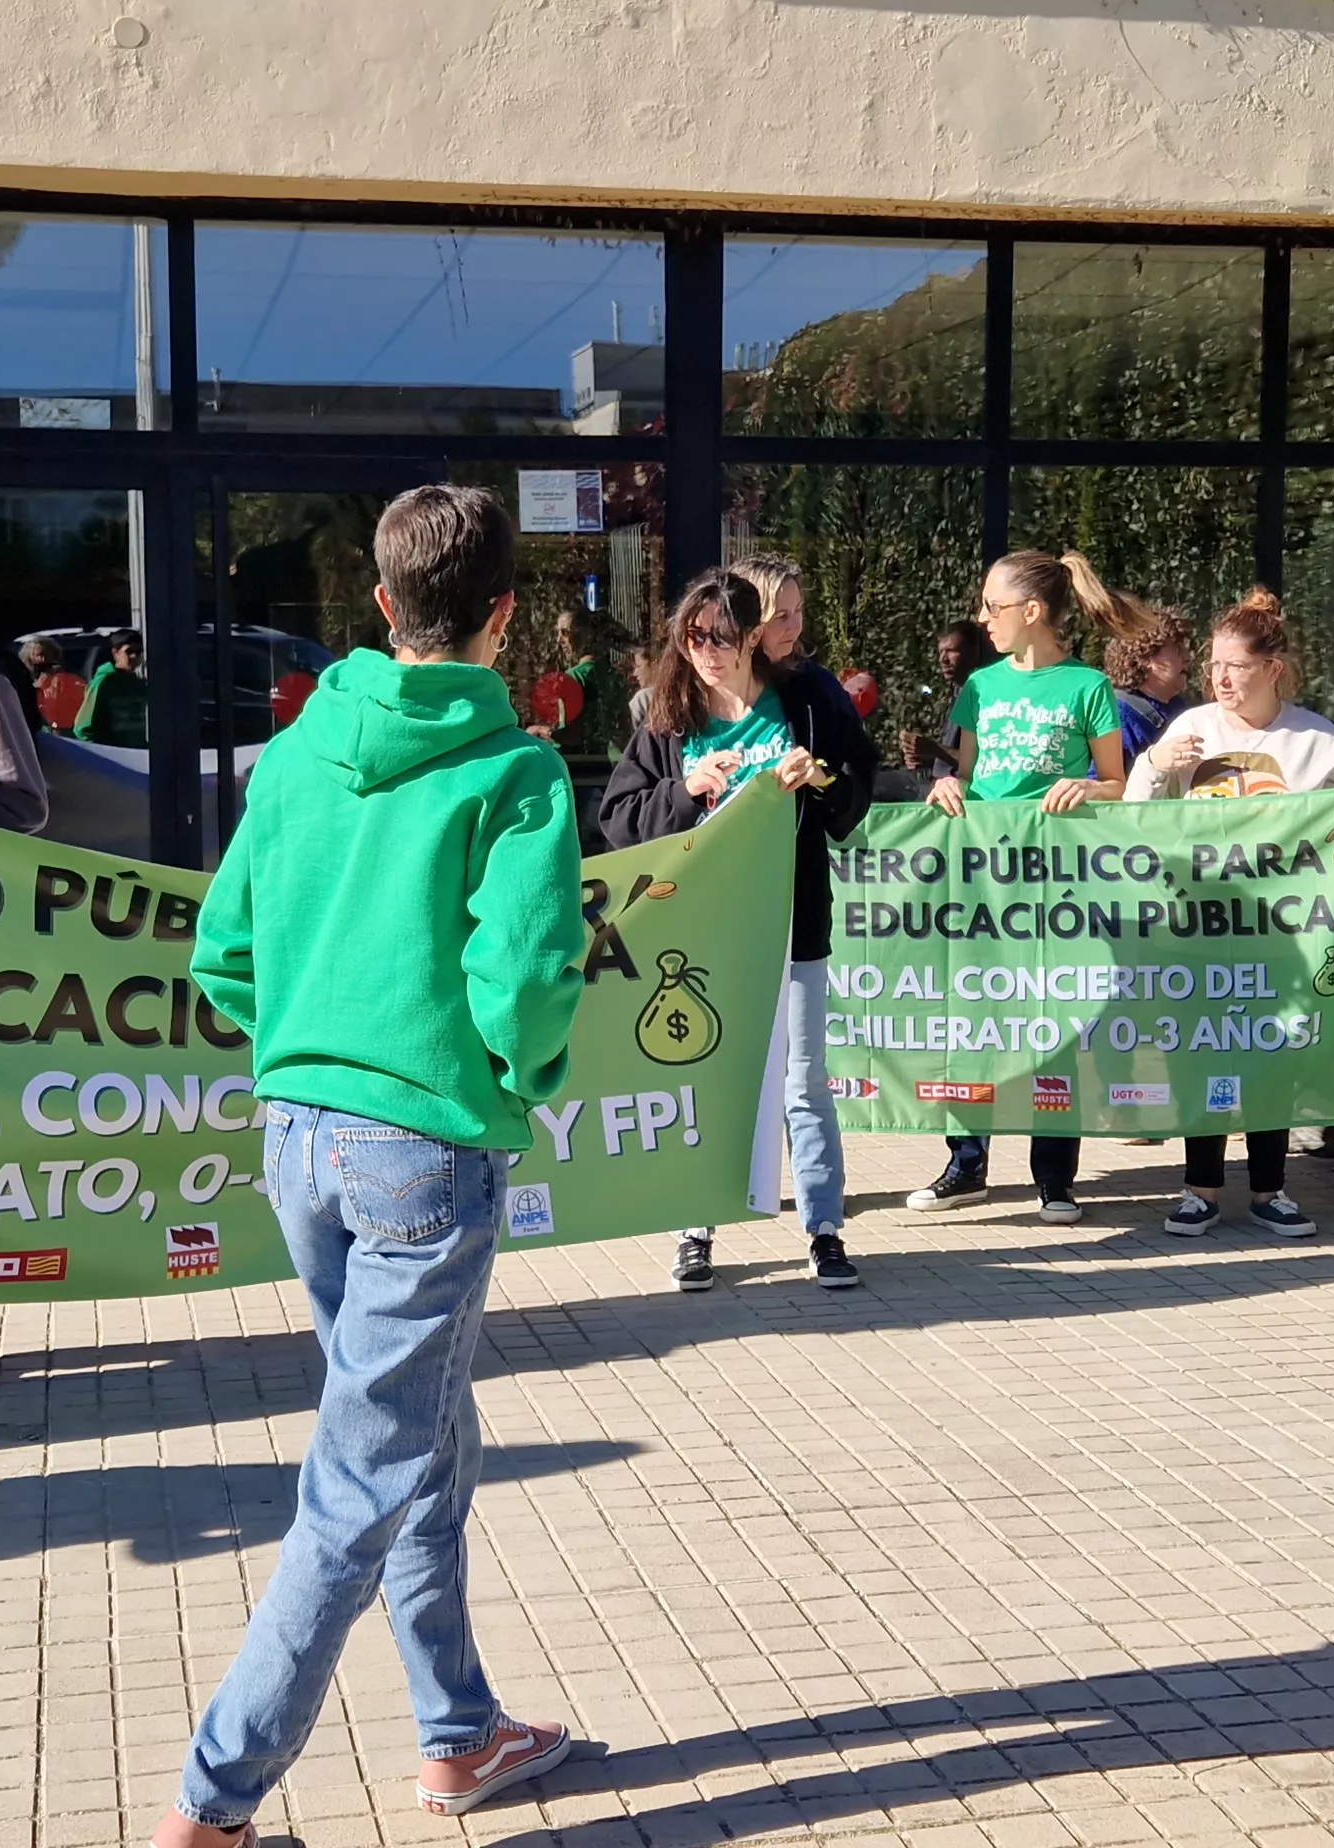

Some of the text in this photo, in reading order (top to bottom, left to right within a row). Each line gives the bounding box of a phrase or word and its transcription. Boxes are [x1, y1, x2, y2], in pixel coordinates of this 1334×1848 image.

[828, 834, 1328, 889] NERO PÚBLICO, PARA
[34, 865, 201, 941] PÚB
[845, 888, 1122, 941] EDUCACIÓN
[892, 965, 945, 1001] AL
[954, 964, 1195, 1002] CONCIERTO
[1205, 963, 1277, 1001] DEL
[825, 1004, 1322, 1052] CHILLERATO Y 0-3 AÑOS!
[918, 1084, 970, 1099] CCOO
[1034, 1095, 1070, 1105] HUSTE
[1111, 1090, 1133, 1100] UGT
[22, 1070, 267, 1137] CONC
[534, 1100, 586, 1162] Y
[600, 1085, 702, 1157] FP!
[512, 1210, 549, 1226] ANPE
[168, 1251, 218, 1268] HUSTE
